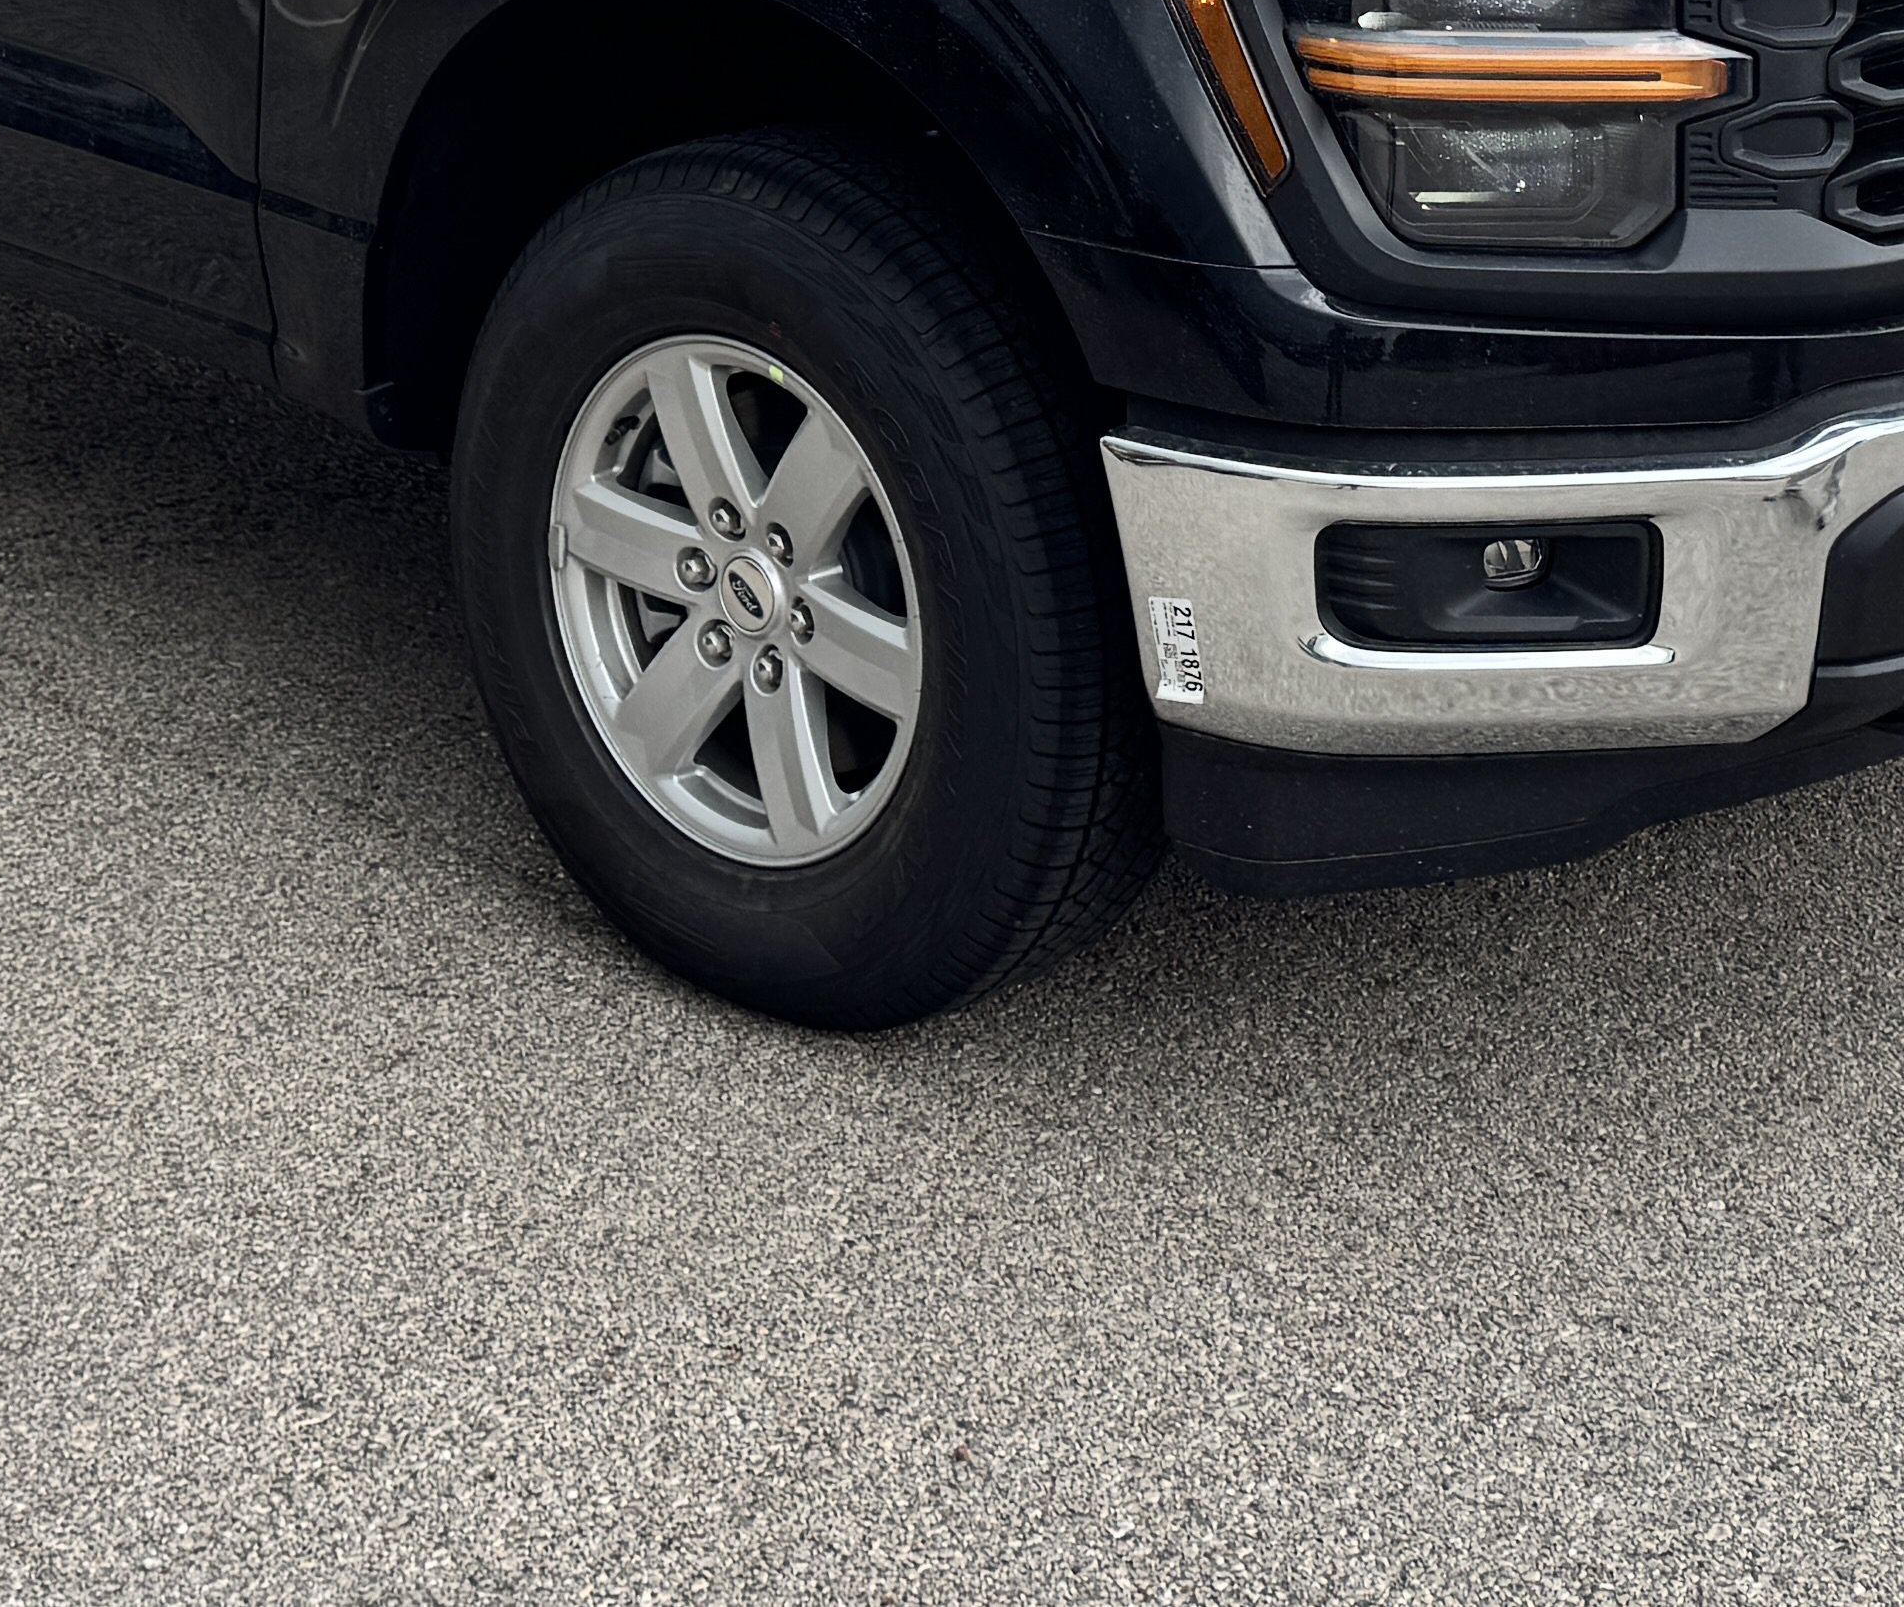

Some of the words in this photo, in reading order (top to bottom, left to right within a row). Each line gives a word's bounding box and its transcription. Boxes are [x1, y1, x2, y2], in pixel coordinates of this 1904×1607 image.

[732, 579, 759, 611] Ford
[1173, 604, 1196, 641] 217
[1180, 647, 1204, 693] 1876
